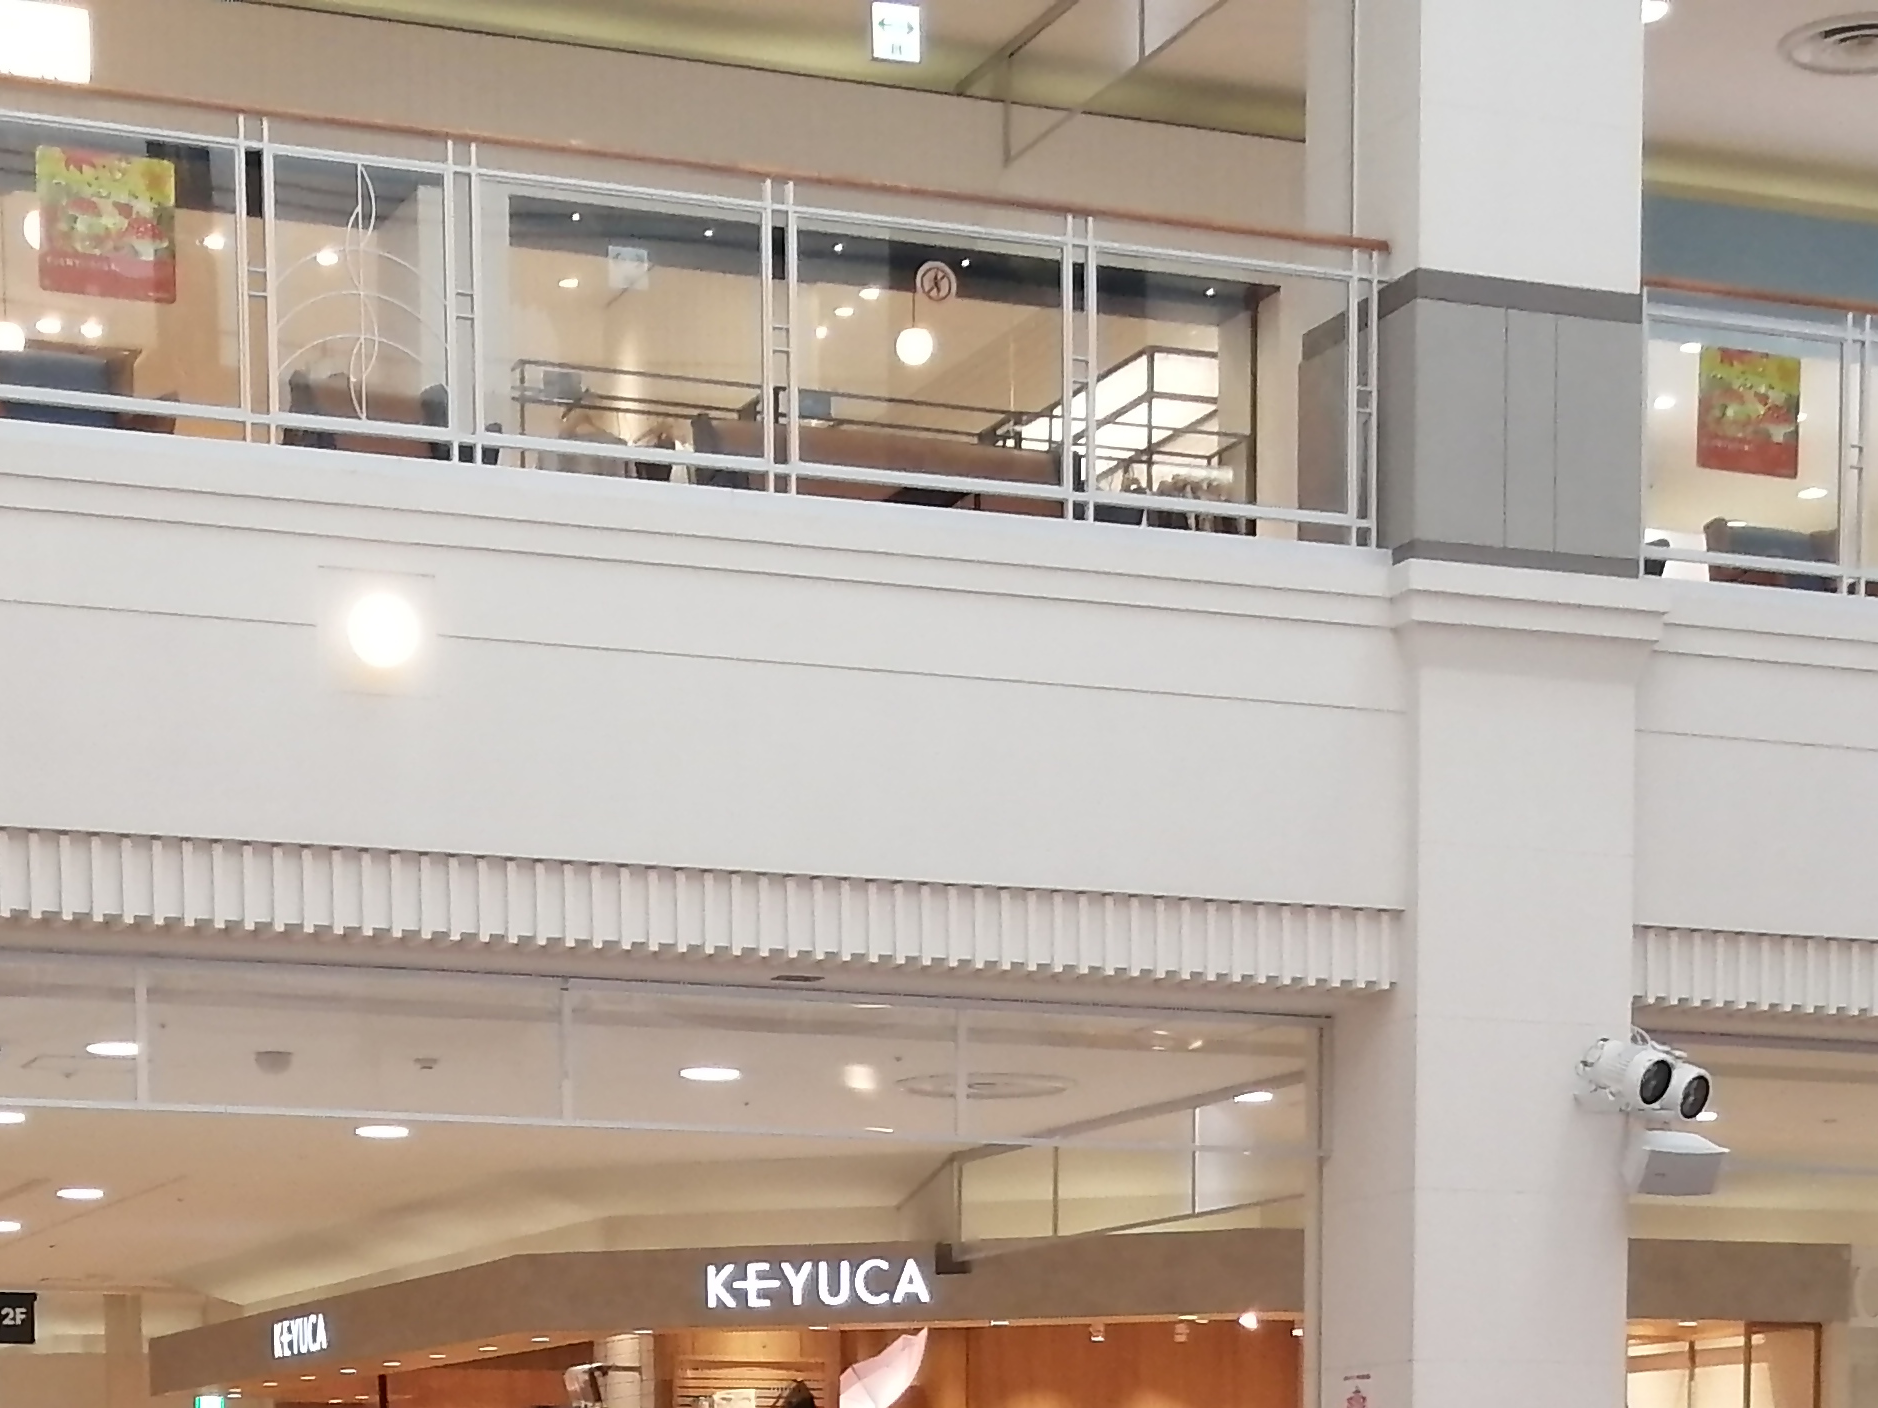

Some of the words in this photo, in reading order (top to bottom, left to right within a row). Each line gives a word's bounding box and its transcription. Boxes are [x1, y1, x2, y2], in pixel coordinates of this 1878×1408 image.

[706, 1257, 931, 1309] KEYUCA
[1, 1307, 27, 1326] 2F
[273, 1313, 329, 1359] KEYUCA
